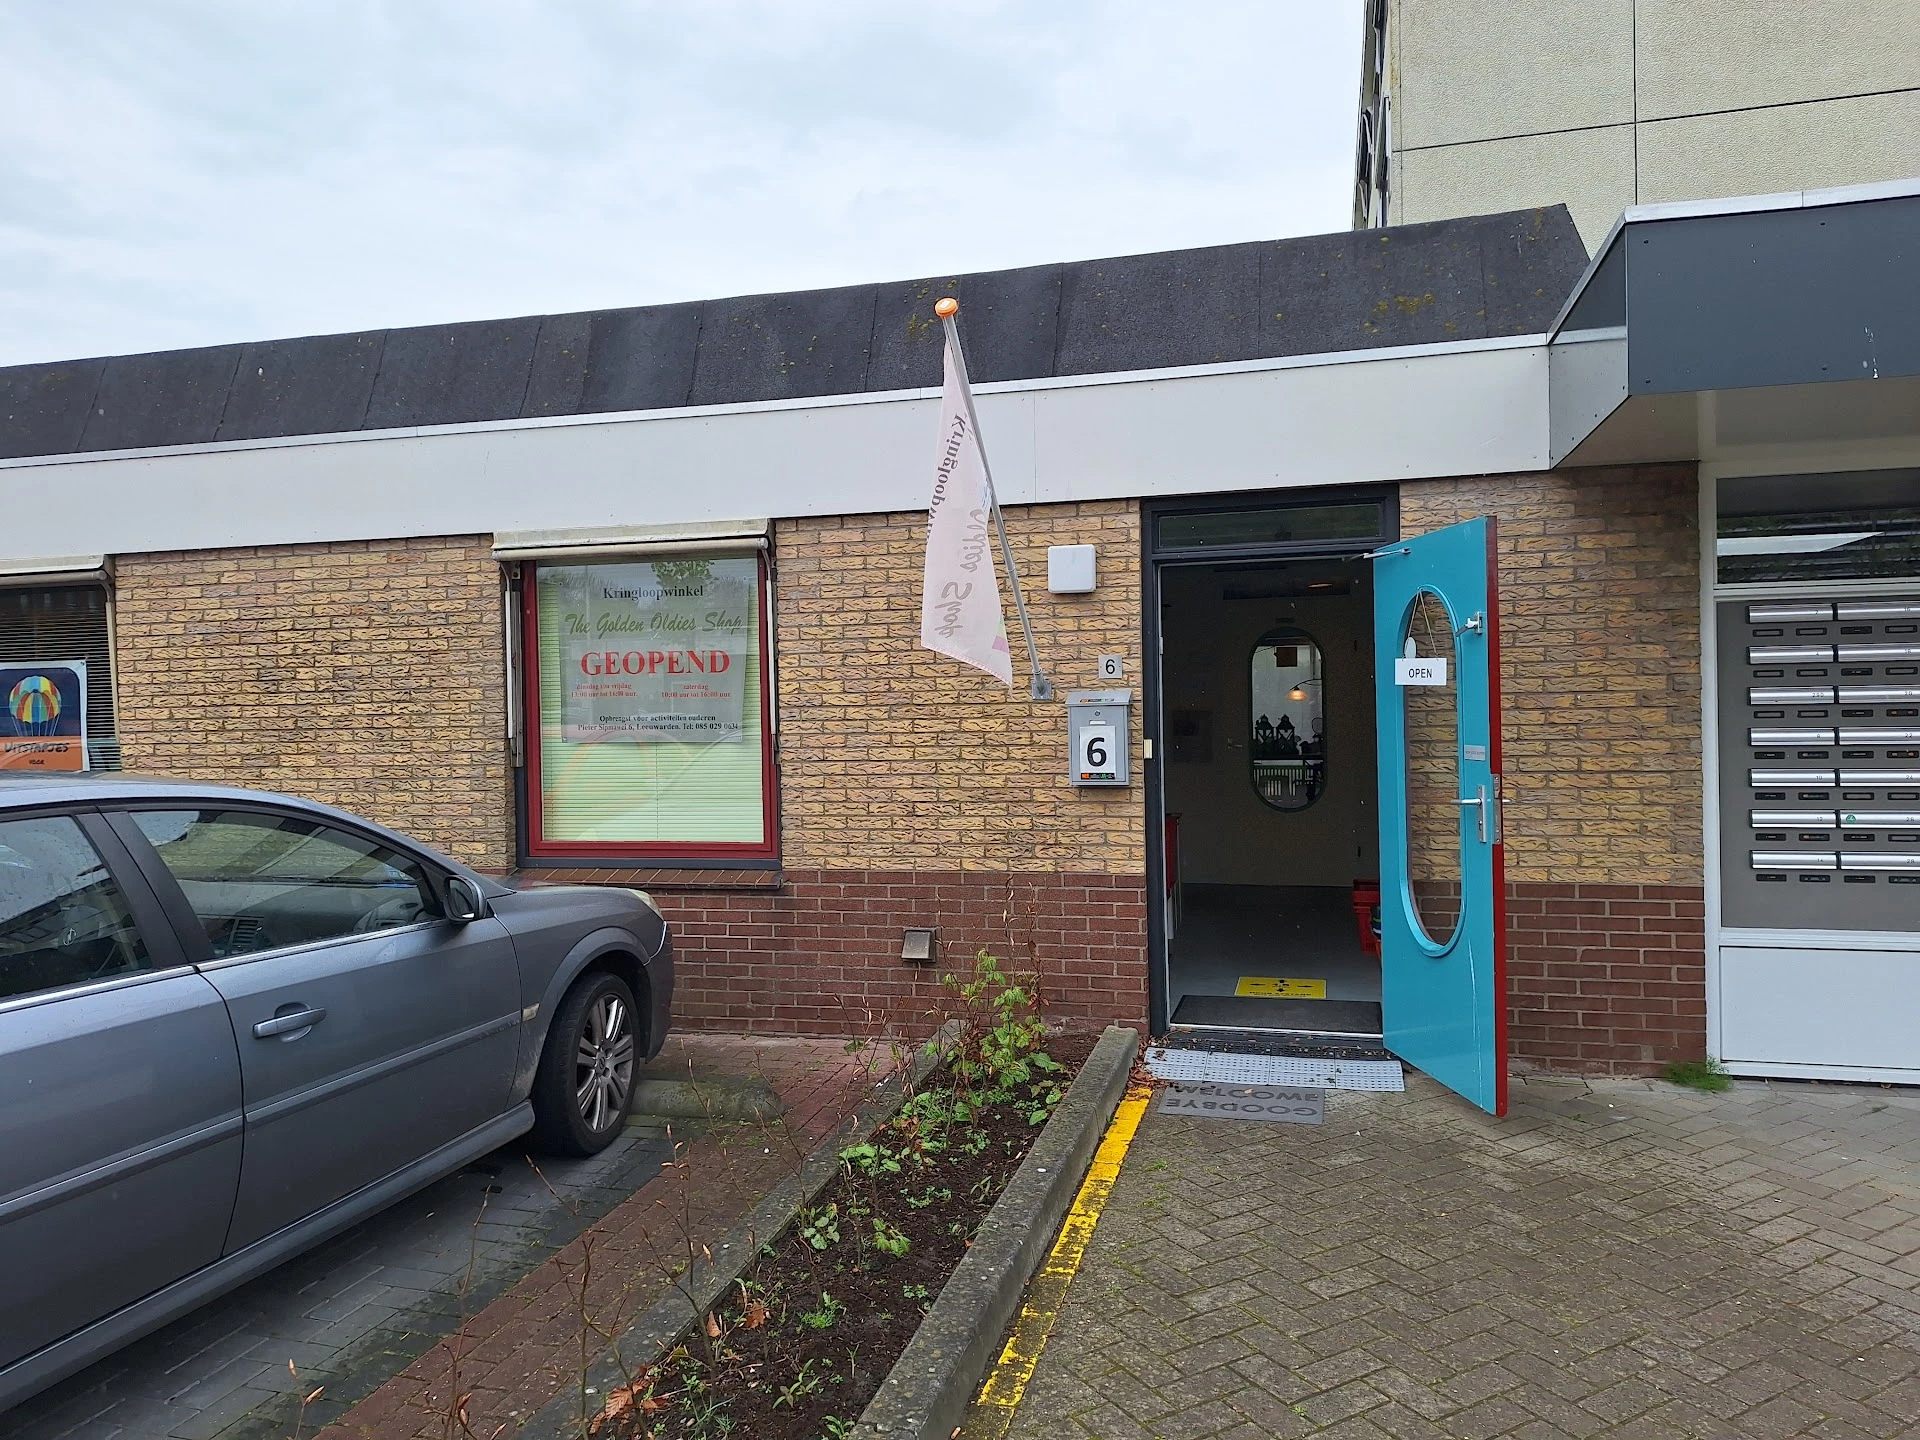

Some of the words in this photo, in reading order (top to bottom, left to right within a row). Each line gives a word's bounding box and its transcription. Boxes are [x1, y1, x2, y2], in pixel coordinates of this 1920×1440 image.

[603, 585, 704, 601] Kringloopwinkel
[564, 614, 590, 635] The
[596, 612, 644, 640] Golden
[650, 611, 696, 632] Oldies
[702, 610, 742, 635] Shop
[581, 650, 731, 676] GEOPEND
[1106, 659, 1115, 674] 6
[1408, 668, 1432, 678] OPEN
[1087, 737, 1107, 767] 6
[1174, 1085, 1318, 1102] WELCOME
[1166, 1098, 1318, 1116] GOODBYE
